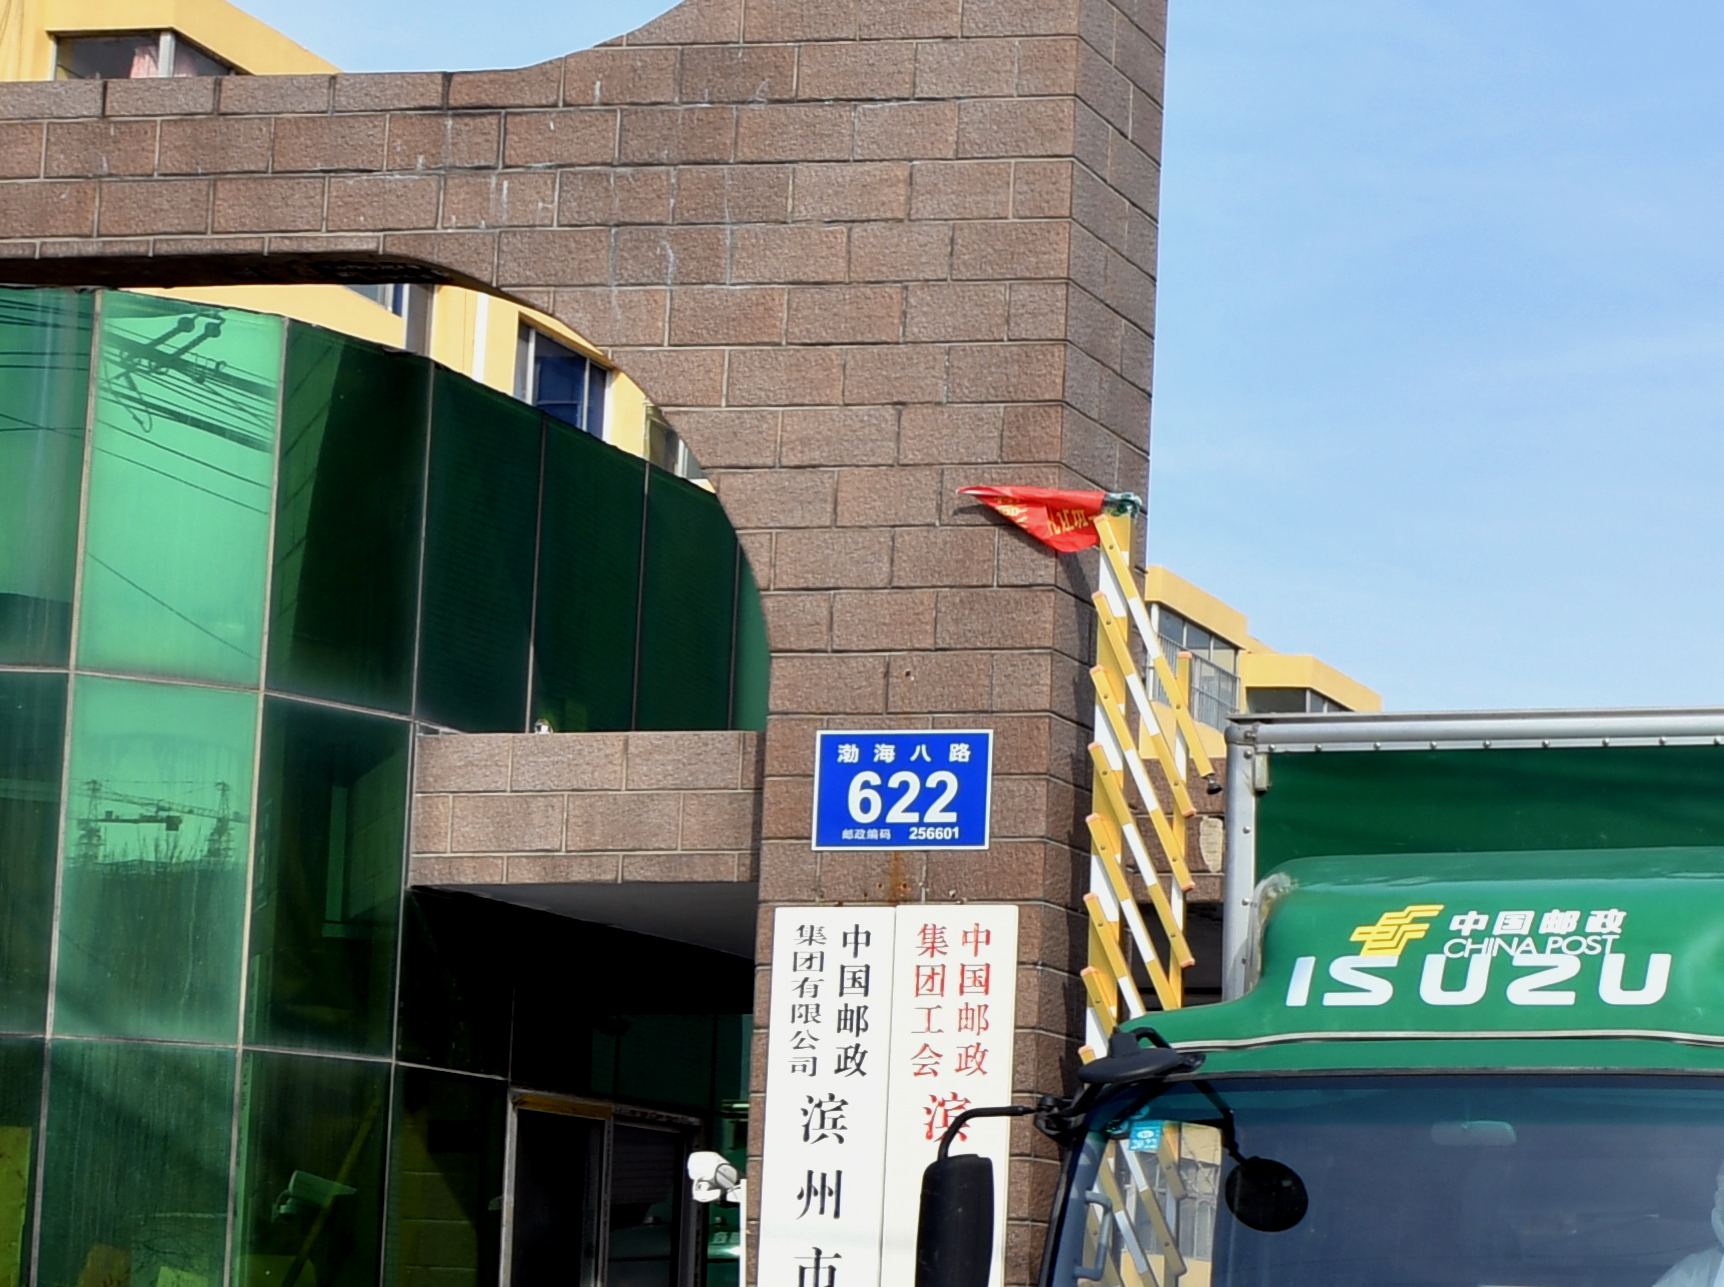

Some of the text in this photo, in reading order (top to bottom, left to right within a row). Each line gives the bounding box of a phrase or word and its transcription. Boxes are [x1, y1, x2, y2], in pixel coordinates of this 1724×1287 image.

[837, 743, 971, 763] 渤海八路
[847, 770, 959, 824] 622
[841, 826, 960, 841] 邮政编码 256601
[1442, 935, 1620, 960] CHINA POST
[1449, 908, 1627, 937] 中国邮政
[788, 924, 828, 1078] 集团有限公司
[833, 922, 873, 1078] 中国邮政
[910, 922, 950, 1078] 集团工会
[953, 922, 992, 1077] 中国邮政
[1285, 953, 1672, 1007] ISUZU
